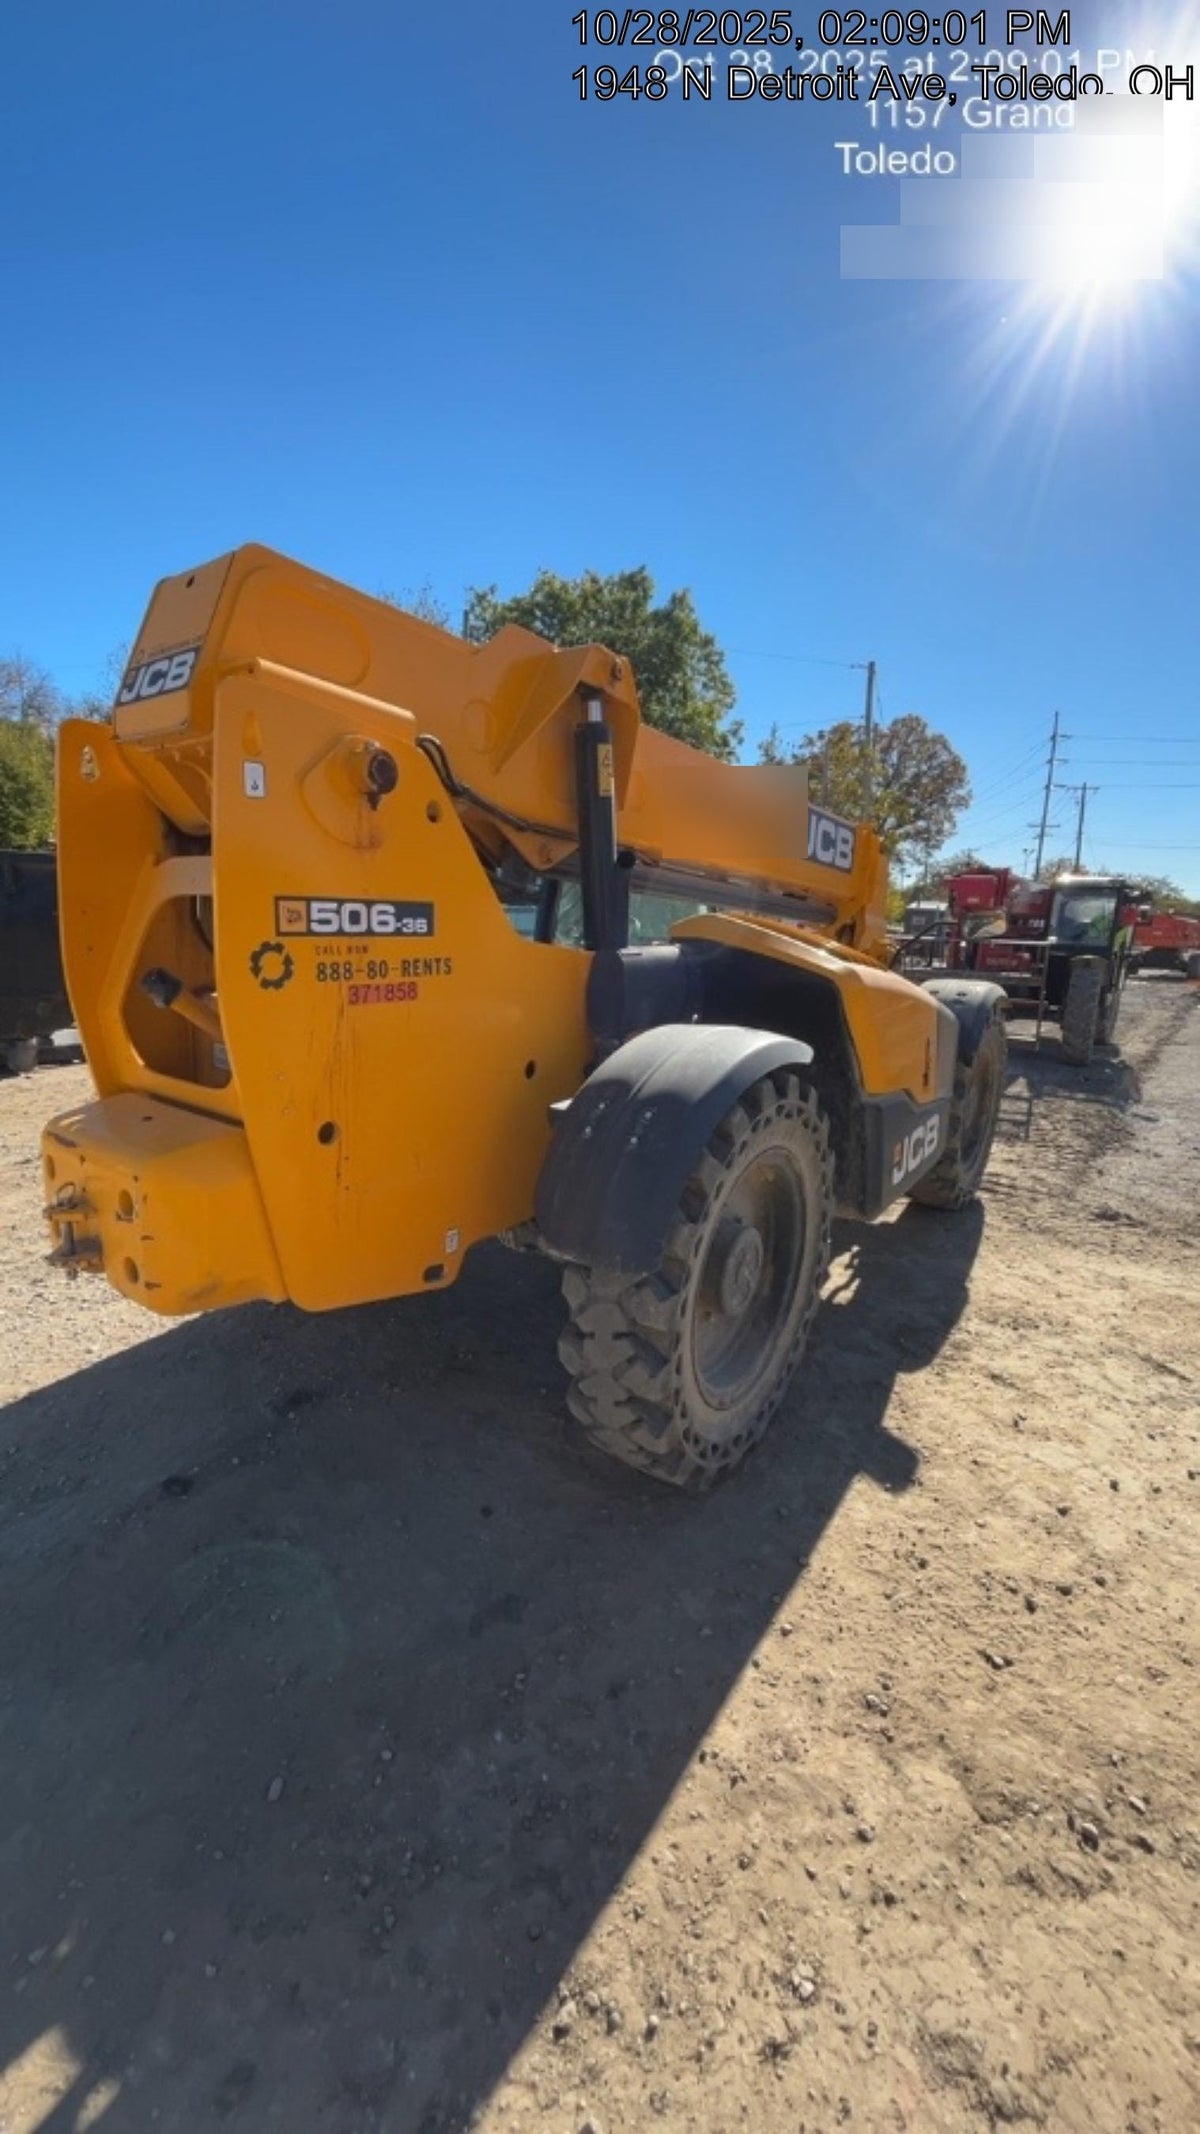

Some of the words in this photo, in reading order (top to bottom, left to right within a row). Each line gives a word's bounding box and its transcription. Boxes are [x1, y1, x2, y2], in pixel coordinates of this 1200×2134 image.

[119, 651, 197, 703] JCB
[310, 901, 428, 934] 506-36
[316, 957, 452, 982] 888-80-RENTS
[348, 982, 418, 1005] 371858
[891, 1113, 940, 1185] JCB
